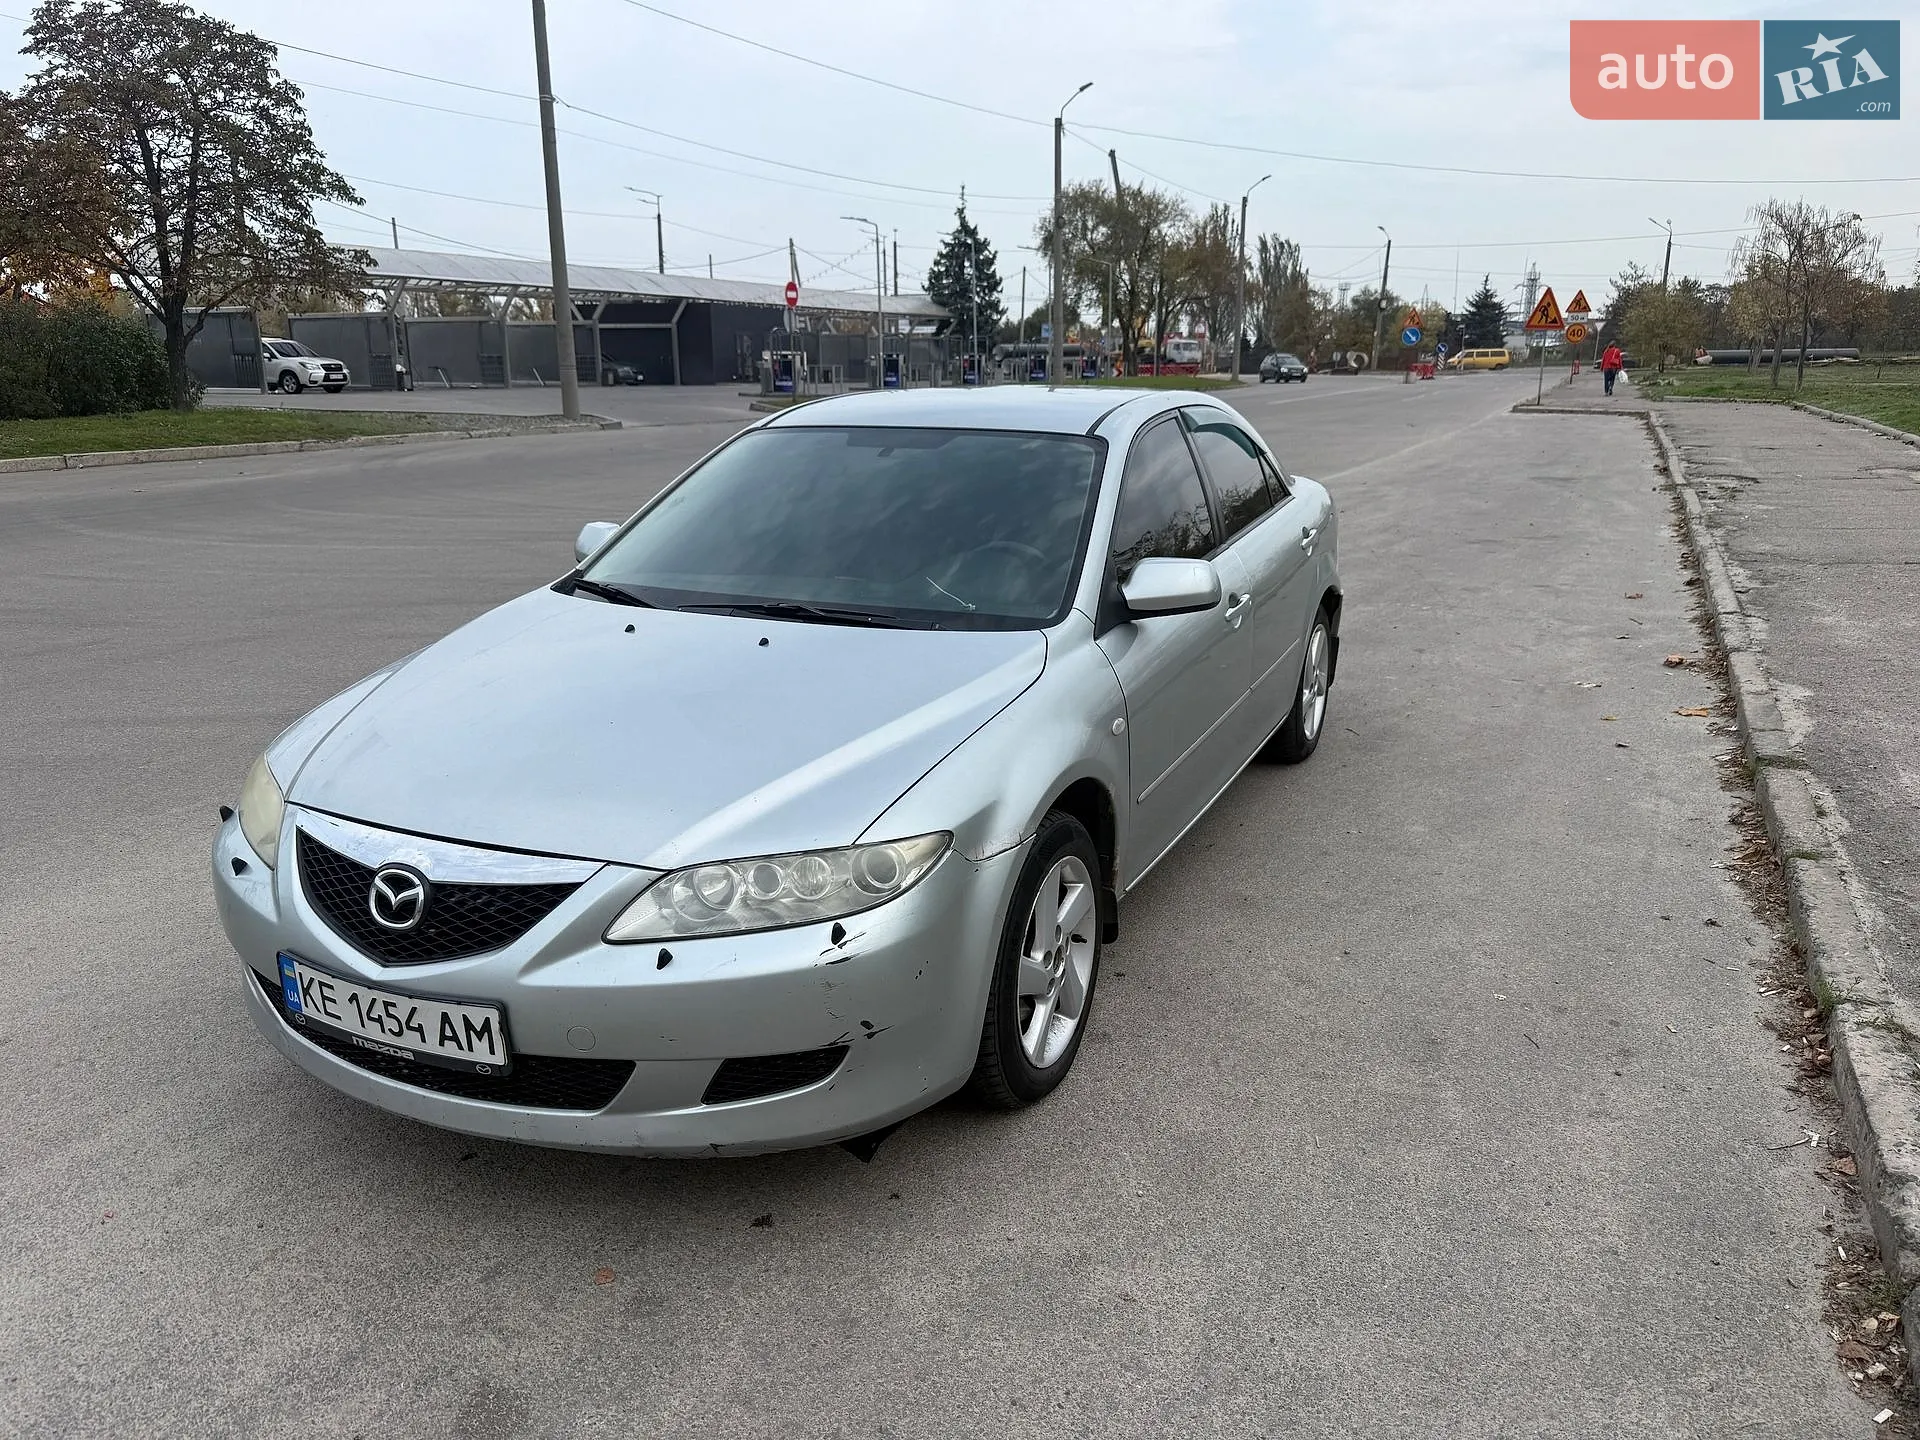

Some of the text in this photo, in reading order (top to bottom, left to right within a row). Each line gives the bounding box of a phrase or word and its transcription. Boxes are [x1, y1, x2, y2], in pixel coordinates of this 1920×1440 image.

[1569, 328, 1583, 338] 40
[287, 989, 300, 1004] UA
[298, 971, 496, 1056] KE 1454 AM
